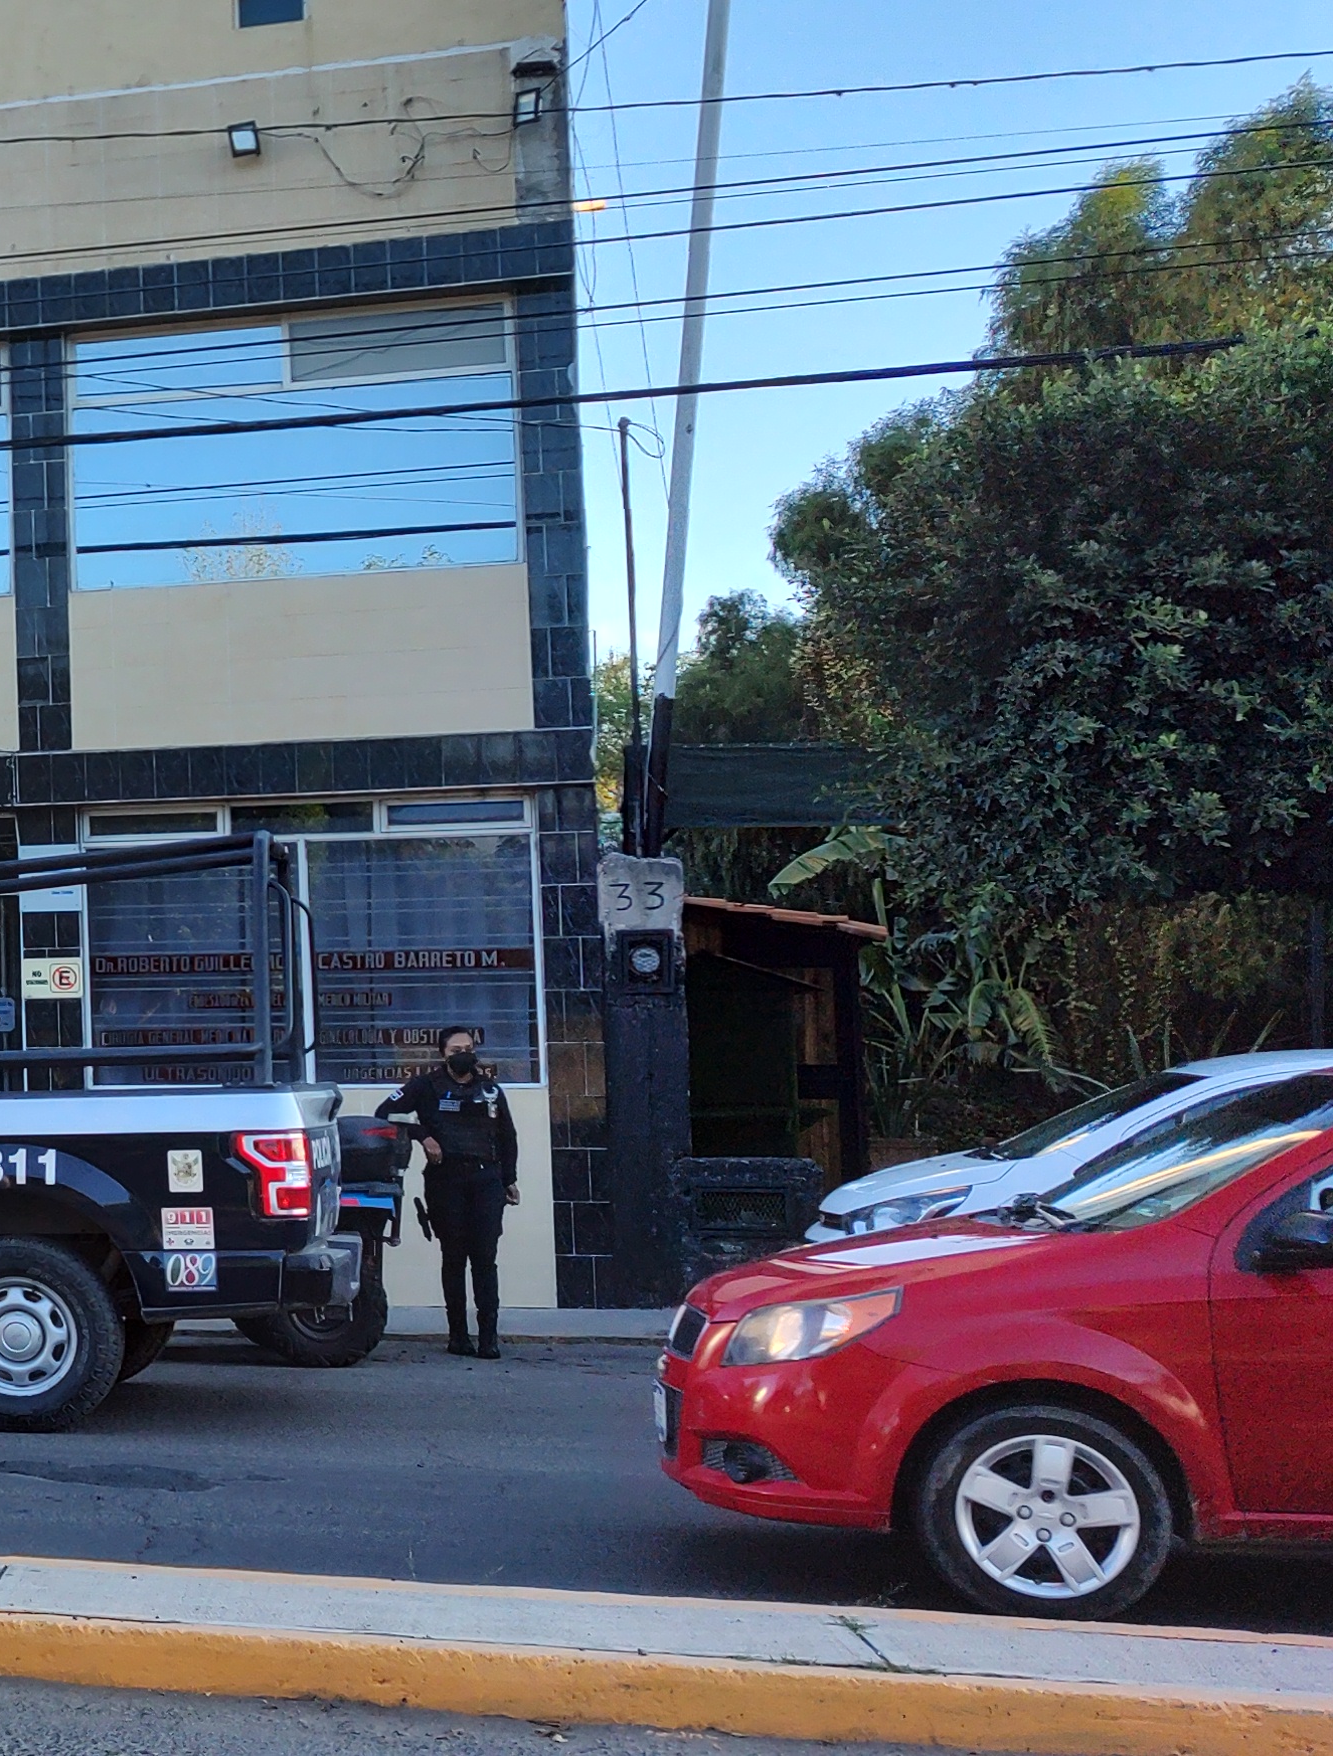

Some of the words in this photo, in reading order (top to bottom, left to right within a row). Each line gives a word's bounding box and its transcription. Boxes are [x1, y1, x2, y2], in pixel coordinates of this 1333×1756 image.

[609, 881, 665, 911] 33
[317, 951, 384, 970] CASTRO
[394, 950, 475, 969] BARRETO
[482, 949, 506, 967] M.
[166, 1211, 209, 1224] 911
[165, 1253, 216, 1287] 089
